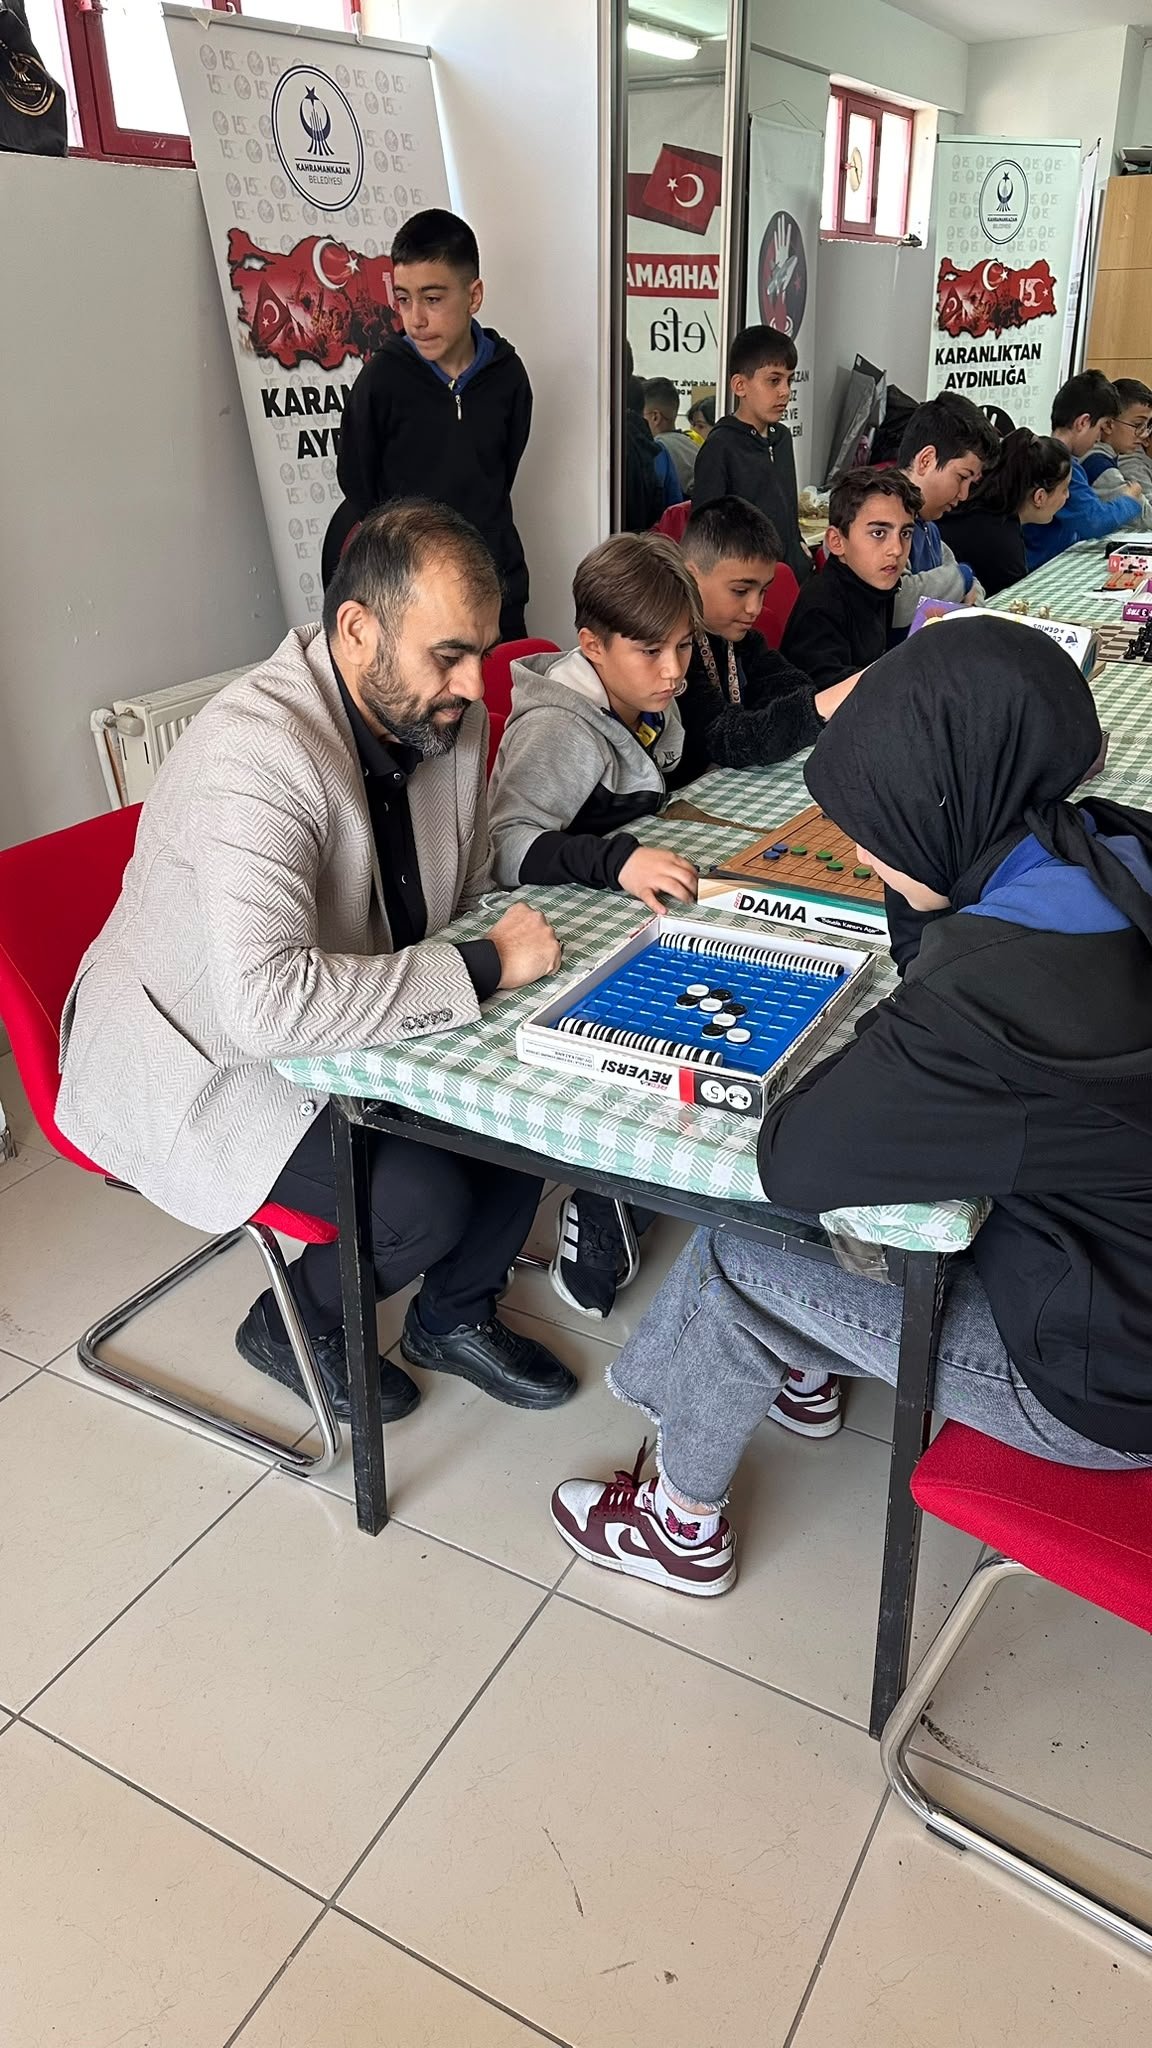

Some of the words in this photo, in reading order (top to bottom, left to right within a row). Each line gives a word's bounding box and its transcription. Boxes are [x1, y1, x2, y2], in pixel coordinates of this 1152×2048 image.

[296, 163, 351, 175] KAHRAMANKAZAN
[309, 175, 343, 185] BELEDİYESİ
[935, 343, 1042, 365] KARANLIKTAN
[945, 365, 1026, 389] AYDINLIĞA
[1033, 624, 1059, 634] GENIUS
[738, 894, 807, 924] DAMA
